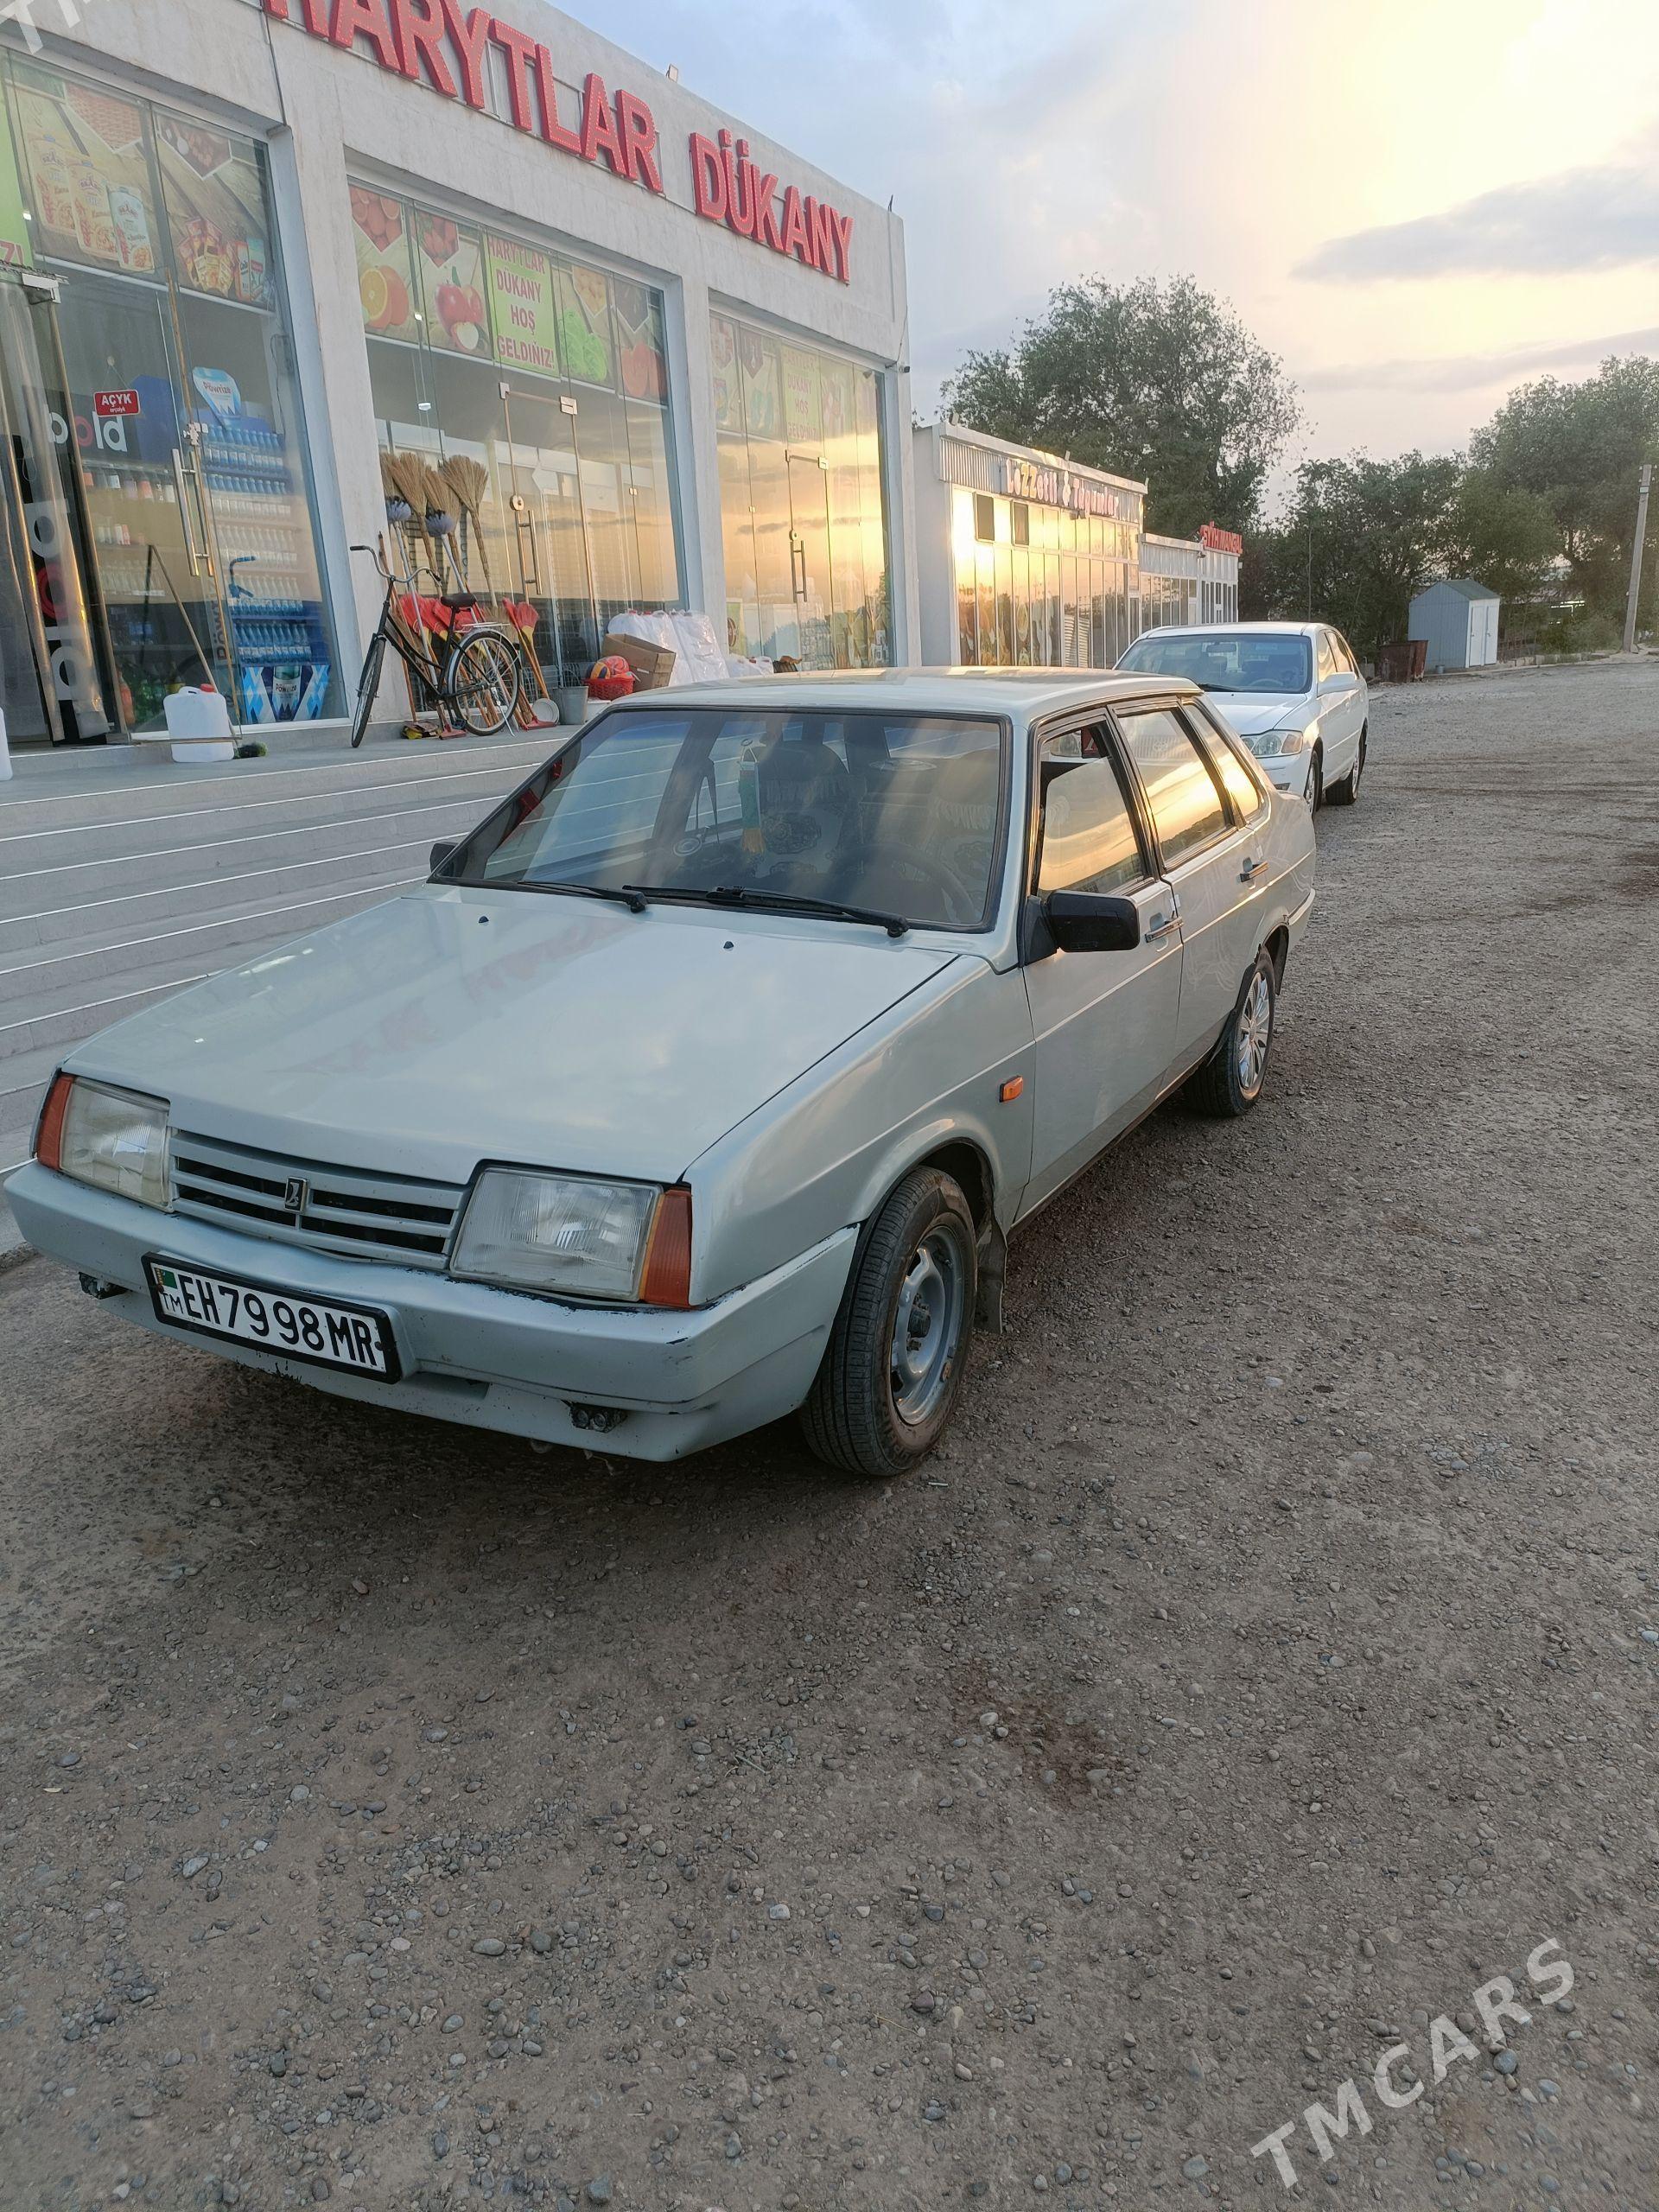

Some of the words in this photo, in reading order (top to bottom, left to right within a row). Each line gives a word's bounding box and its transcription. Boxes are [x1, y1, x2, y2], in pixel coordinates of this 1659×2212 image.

[690, 129, 854, 282] DÜKANY
[487, 234, 545, 274] HARYTLAR
[496, 267, 541, 303] DÜKANY
[511, 304, 536, 335] HOŞ
[101, 393, 132, 407] AÇYK
[161, 1292, 184, 1314] TM
[178, 1274, 378, 1367] EH7998MR
